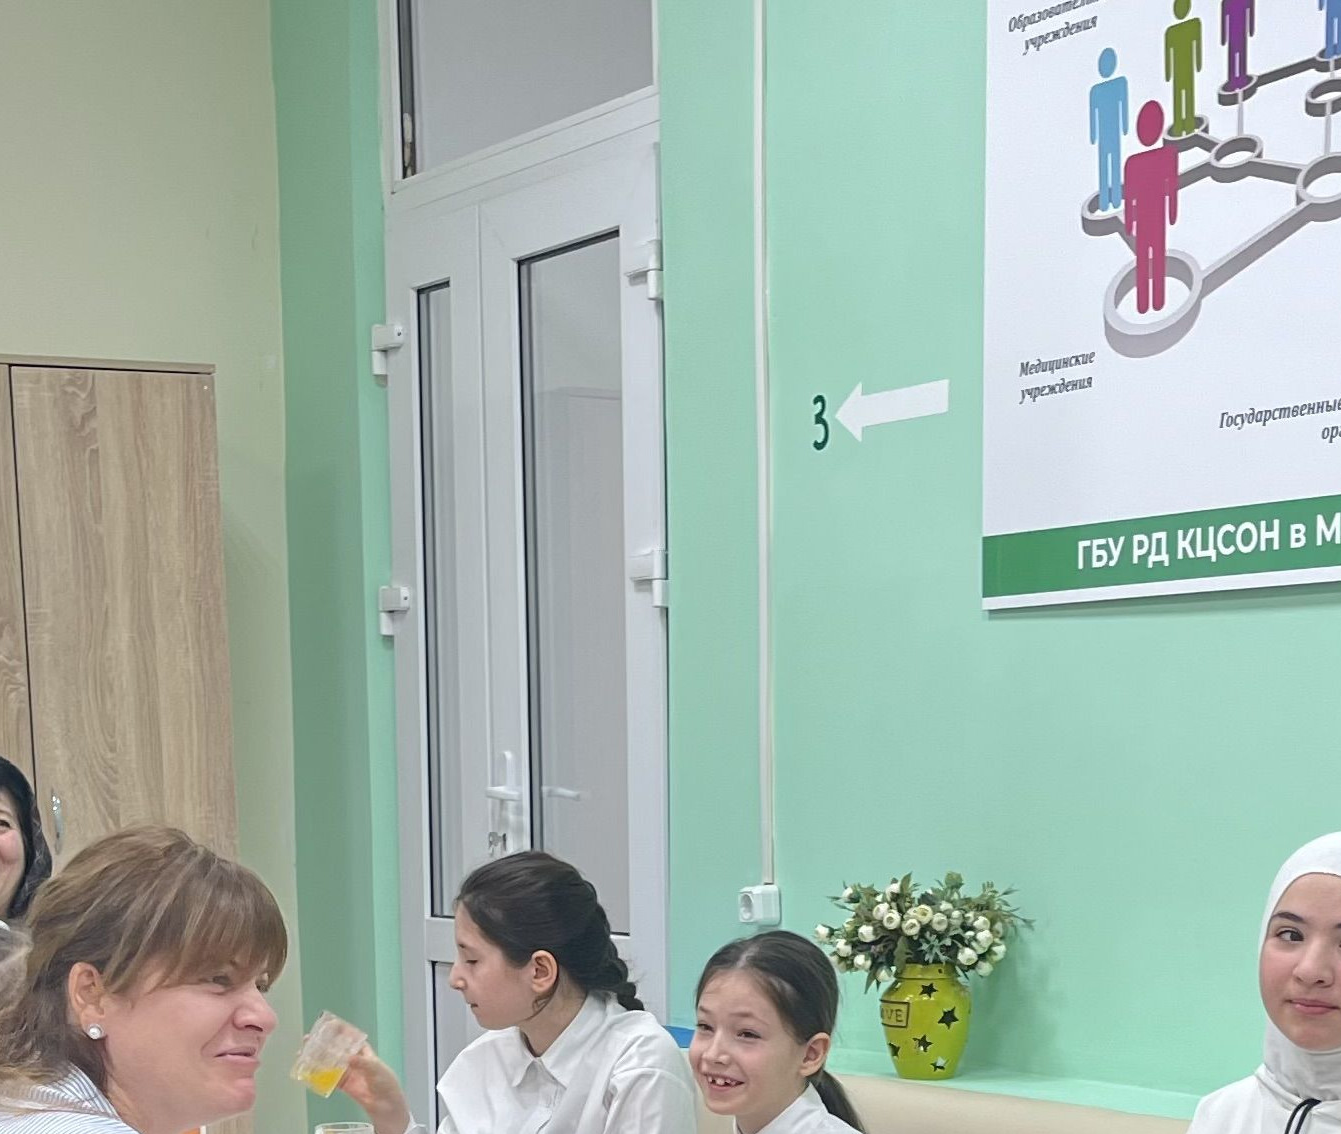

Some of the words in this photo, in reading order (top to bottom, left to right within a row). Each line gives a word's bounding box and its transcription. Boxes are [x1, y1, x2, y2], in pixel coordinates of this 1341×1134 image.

[1022, 15, 1098, 56] учреждения
[1019, 352, 1096, 377] Медицинские
[1019, 377, 1093, 404] учреждения
[813, 394, 829, 451] 3
[1077, 536, 1126, 570] ГБУ
[1132, 531, 1169, 567] РД
[1177, 519, 1280, 563] КЦСОН
[1289, 527, 1306, 549] в
